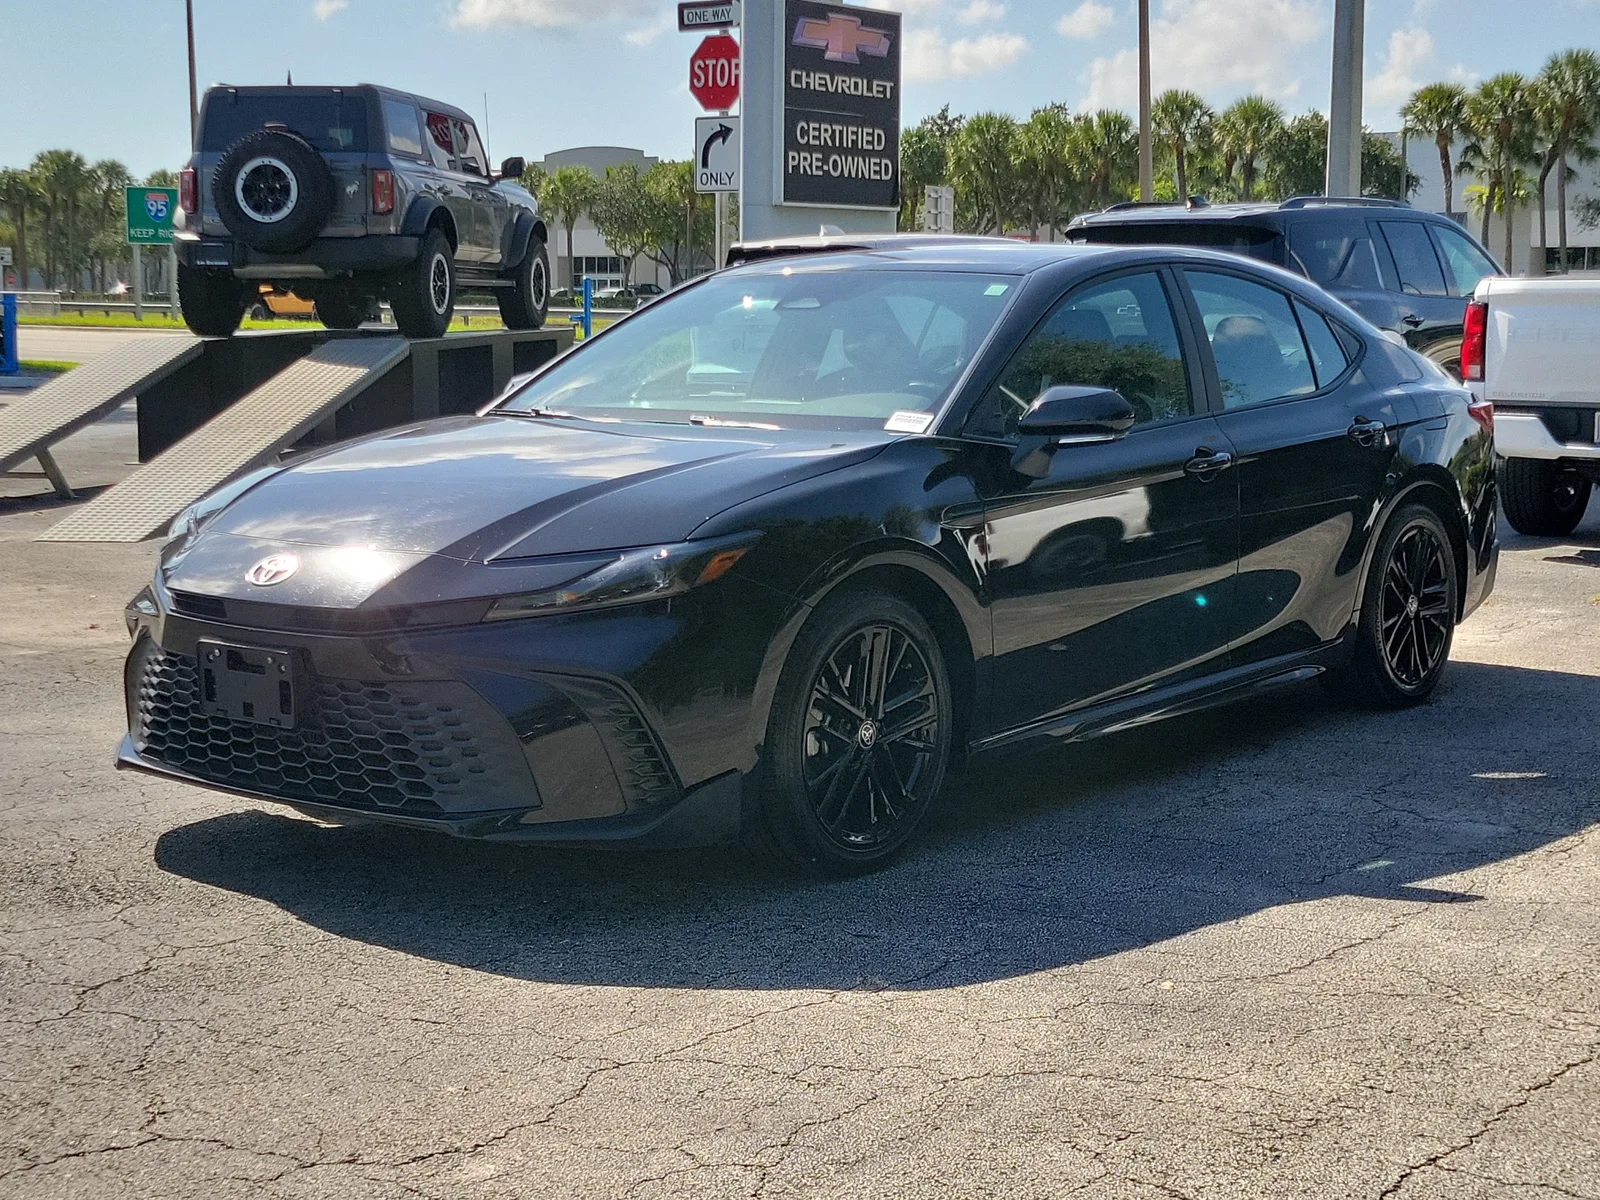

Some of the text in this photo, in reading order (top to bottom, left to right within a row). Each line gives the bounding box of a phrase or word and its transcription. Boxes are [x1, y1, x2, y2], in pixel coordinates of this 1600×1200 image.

[687, 7, 731, 23] ONE WAY
[693, 58, 741, 88] STOP
[790, 70, 894, 99] CHEVROLET
[796, 121, 886, 151] CERTIFIED
[788, 151, 893, 181] PRE-OWNED
[700, 172, 735, 186] ONLY
[147, 200, 167, 217] 95
[130, 229, 155, 238] KEEP
